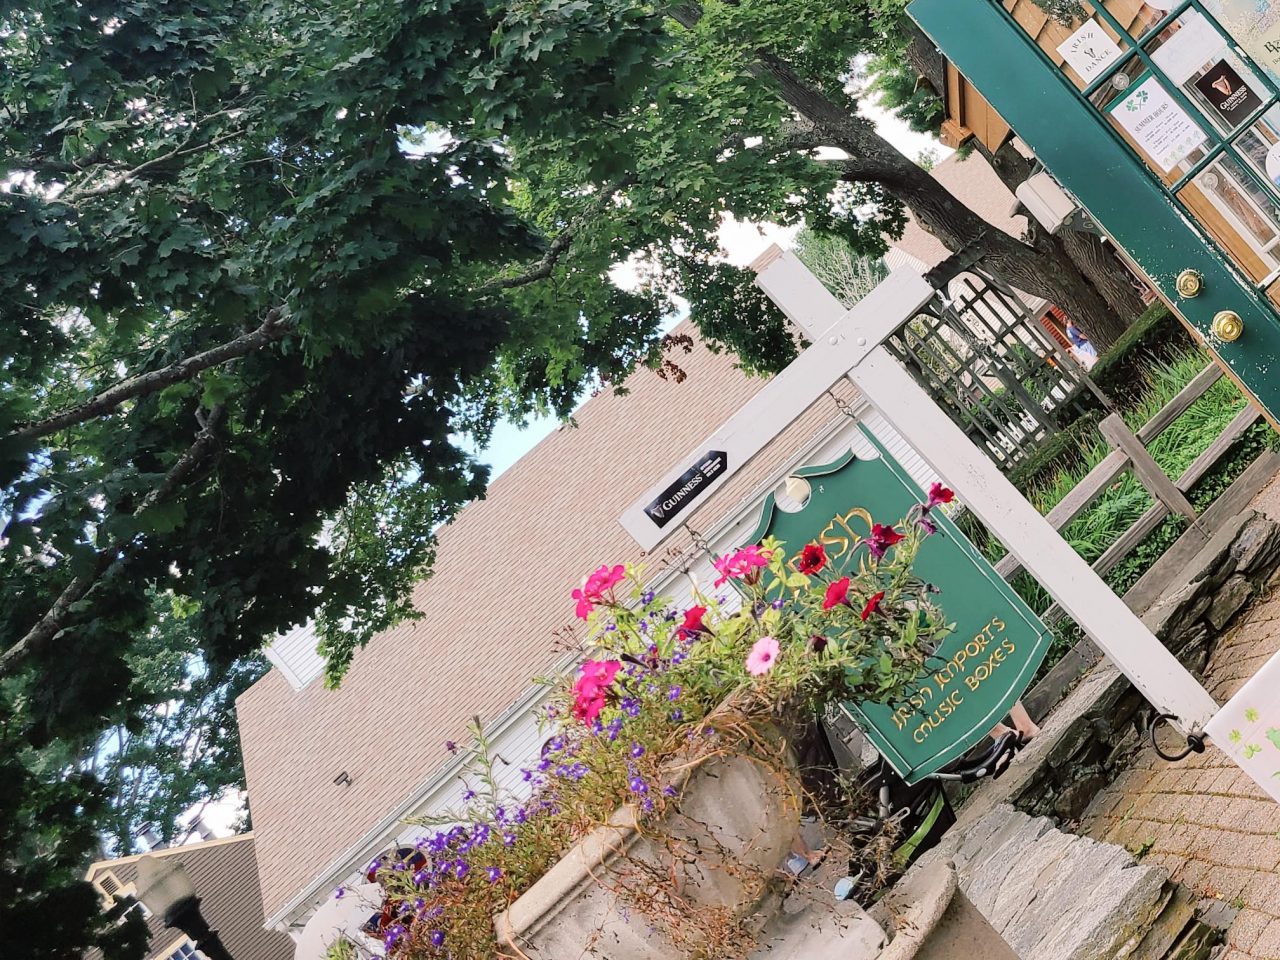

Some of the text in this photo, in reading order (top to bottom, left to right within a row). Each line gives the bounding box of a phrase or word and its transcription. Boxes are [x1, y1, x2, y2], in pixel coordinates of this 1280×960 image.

[1069, 31, 1095, 54] IRISH
[1085, 48, 1113, 74] DANCE
[1219, 85, 1249, 112] GUINNESS
[662, 473, 703, 511] GUINNESS
[889, 616, 1006, 733] IRISH IMPORTS
[912, 639, 1016, 745] MUSIC BOXES
